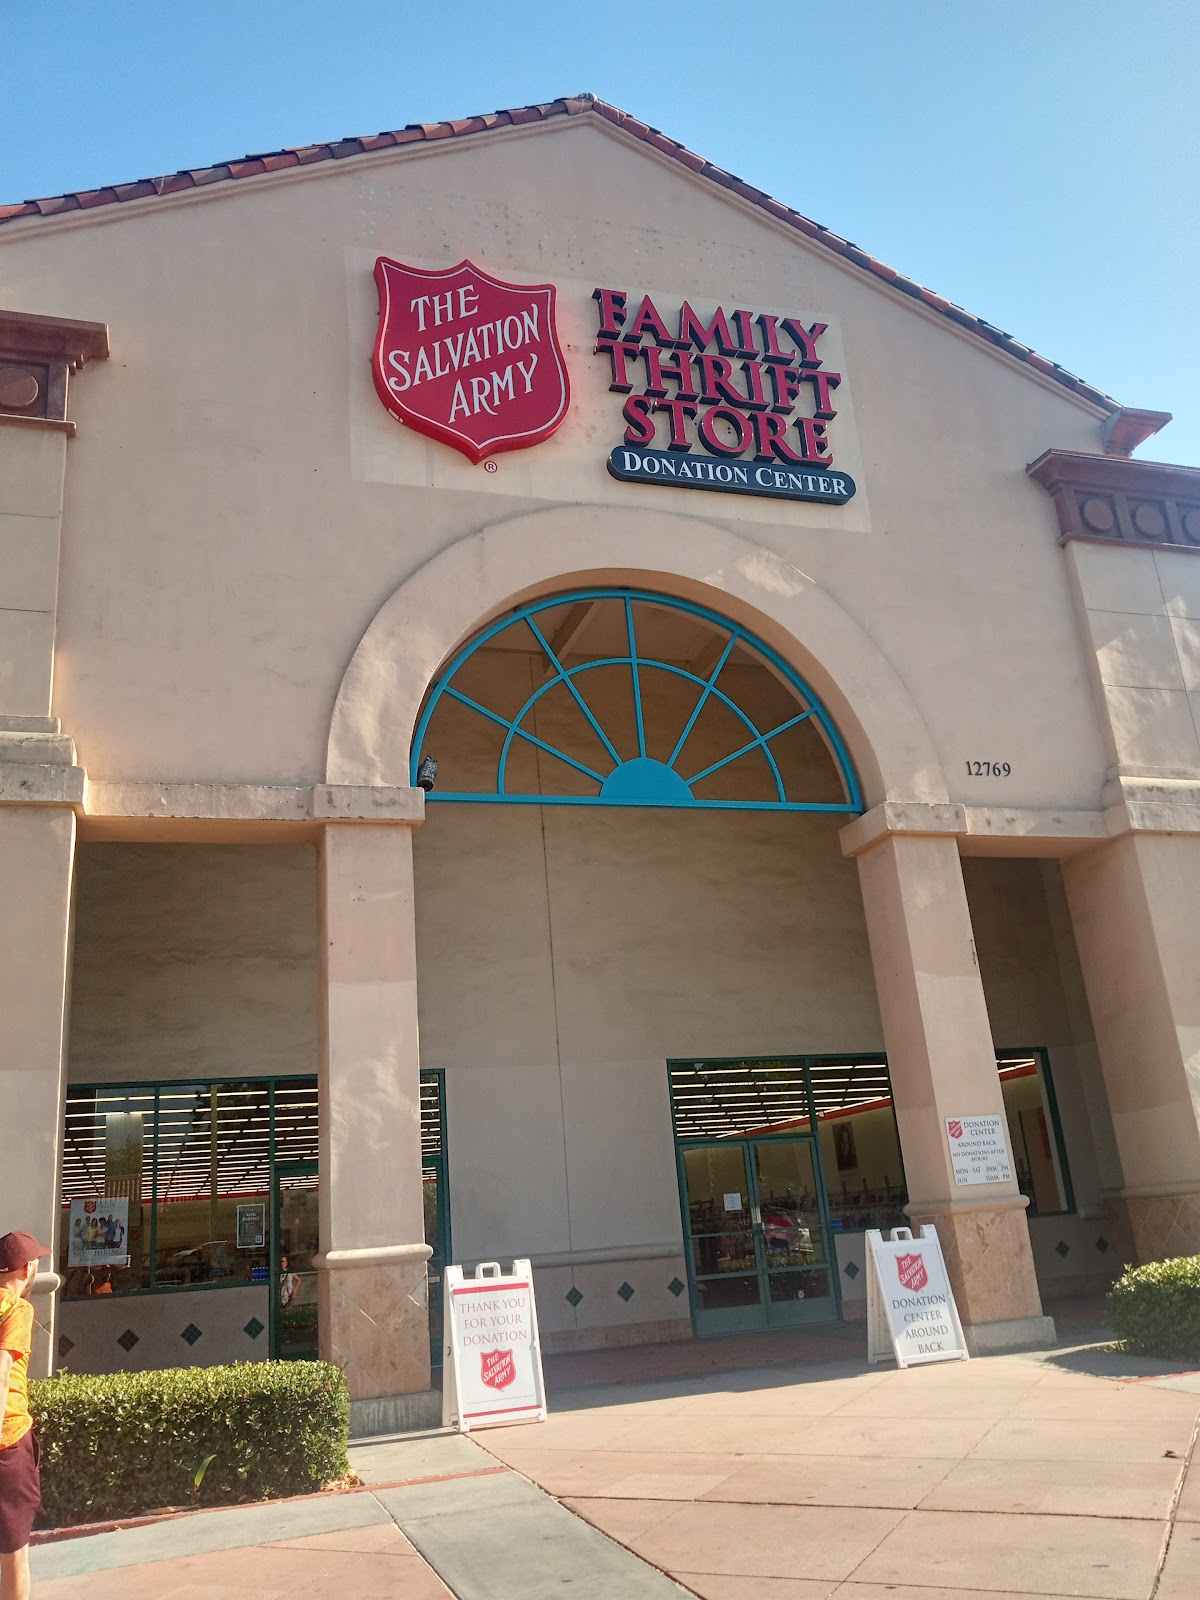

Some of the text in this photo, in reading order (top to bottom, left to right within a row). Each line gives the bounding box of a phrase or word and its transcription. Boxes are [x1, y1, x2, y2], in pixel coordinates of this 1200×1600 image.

[410, 285, 479, 332] THE
[593, 288, 828, 368] FAMILY
[388, 303, 541, 391] SALVATION
[594, 338, 841, 419] THRIFT
[448, 352, 538, 423] ARMY
[623, 394, 833, 469] STORE
[622, 451, 849, 496] DONATION CENTER
[966, 761, 1011, 777] 12769
[963, 1120, 1000, 1129] DONATION
[970, 1128, 997, 1136] CENTER
[94, 1248, 123, 1256] HIRING
[901, 1256, 912, 1270] THE
[911, 1268, 924, 1289] ARMY
[459, 1298, 525, 1313] THANK YOU
[892, 1294, 946, 1310] DONATION
[464, 1314, 523, 1329] FOR YOUR
[904, 1310, 943, 1323] CENTER
[463, 1330, 527, 1346] DONATION
[905, 1325, 949, 1340] AROUND
[917, 1341, 945, 1354] BACK
[483, 1353, 511, 1382] SALVATION
[487, 1352, 499, 1367] THE
[494, 1365, 511, 1387] ARMY
